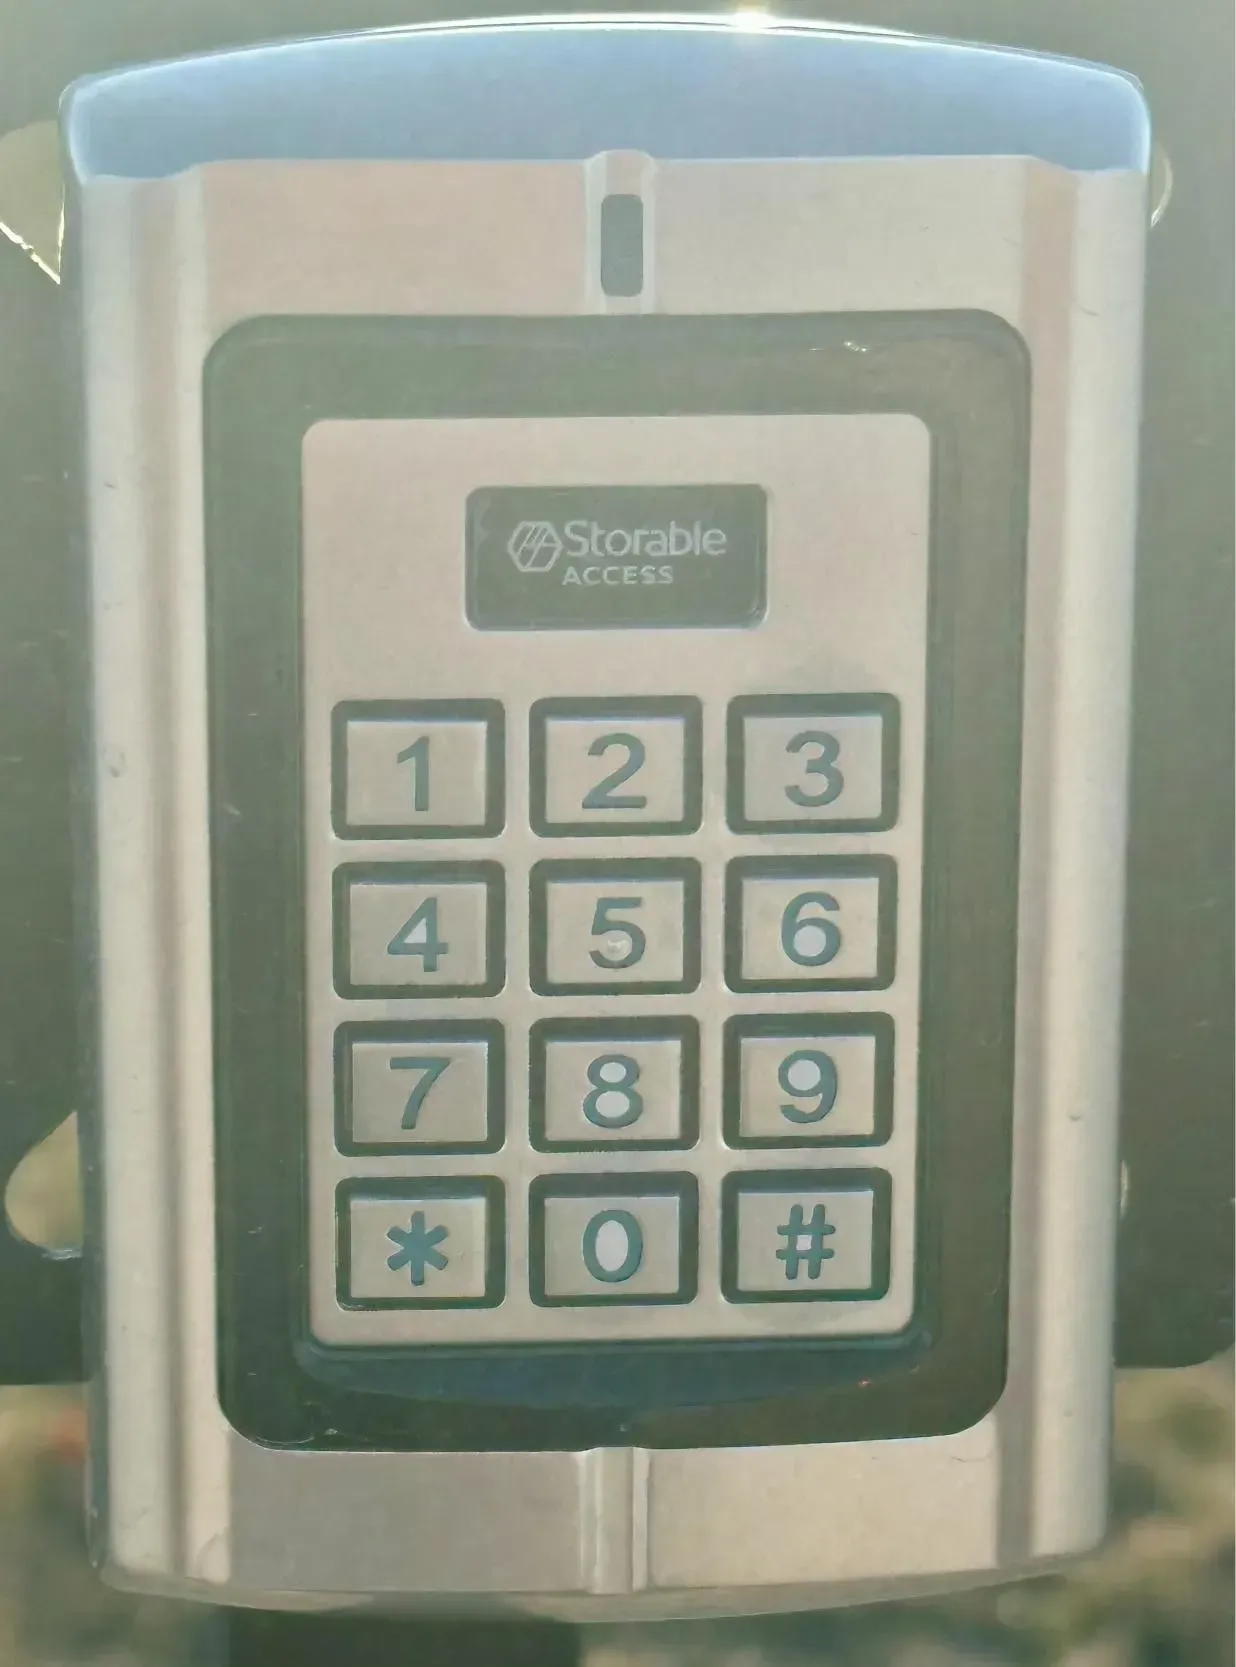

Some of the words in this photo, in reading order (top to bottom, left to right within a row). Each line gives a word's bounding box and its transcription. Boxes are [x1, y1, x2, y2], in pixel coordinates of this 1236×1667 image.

[562, 566, 674, 585] ACCESS
[564, 520, 728, 556] Storable
[396, 736, 430, 812] 1
[581, 732, 648, 809] 2
[784, 731, 844, 807] 3
[387, 897, 449, 972] 4
[589, 897, 646, 969] 5
[780, 891, 841, 967] 6
[389, 1056, 450, 1130] 7
[582, 1054, 643, 1129] 8
[777, 1049, 837, 1124] 9
[582, 1209, 643, 1283] 0
[775, 1203, 835, 1280] #
